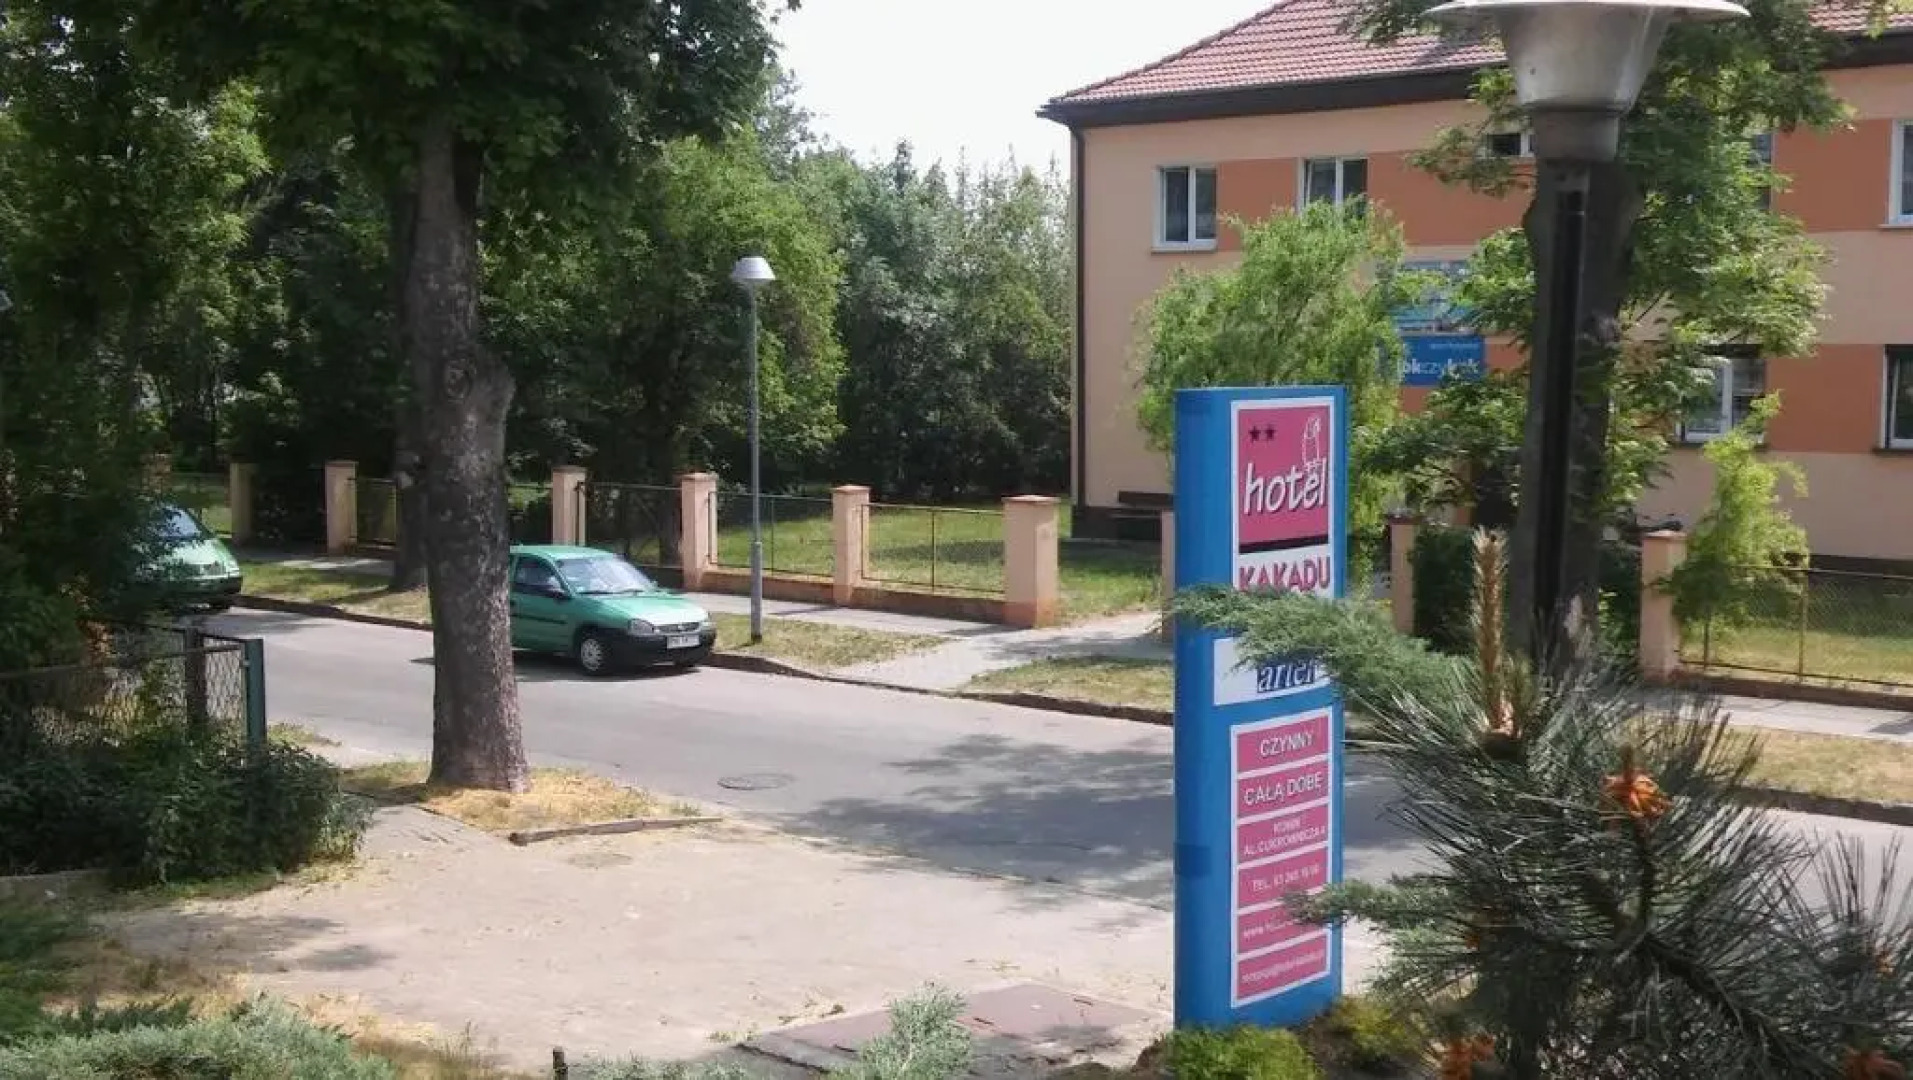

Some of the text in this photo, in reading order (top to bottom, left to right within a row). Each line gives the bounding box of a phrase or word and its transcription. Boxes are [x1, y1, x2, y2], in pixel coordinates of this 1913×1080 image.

[1244, 458, 1327, 514] hotel
[1239, 556, 1331, 592] KAKADU
[1261, 730, 1314, 757] CZYNNY
[1245, 783, 1285, 806] CAŁĄ
